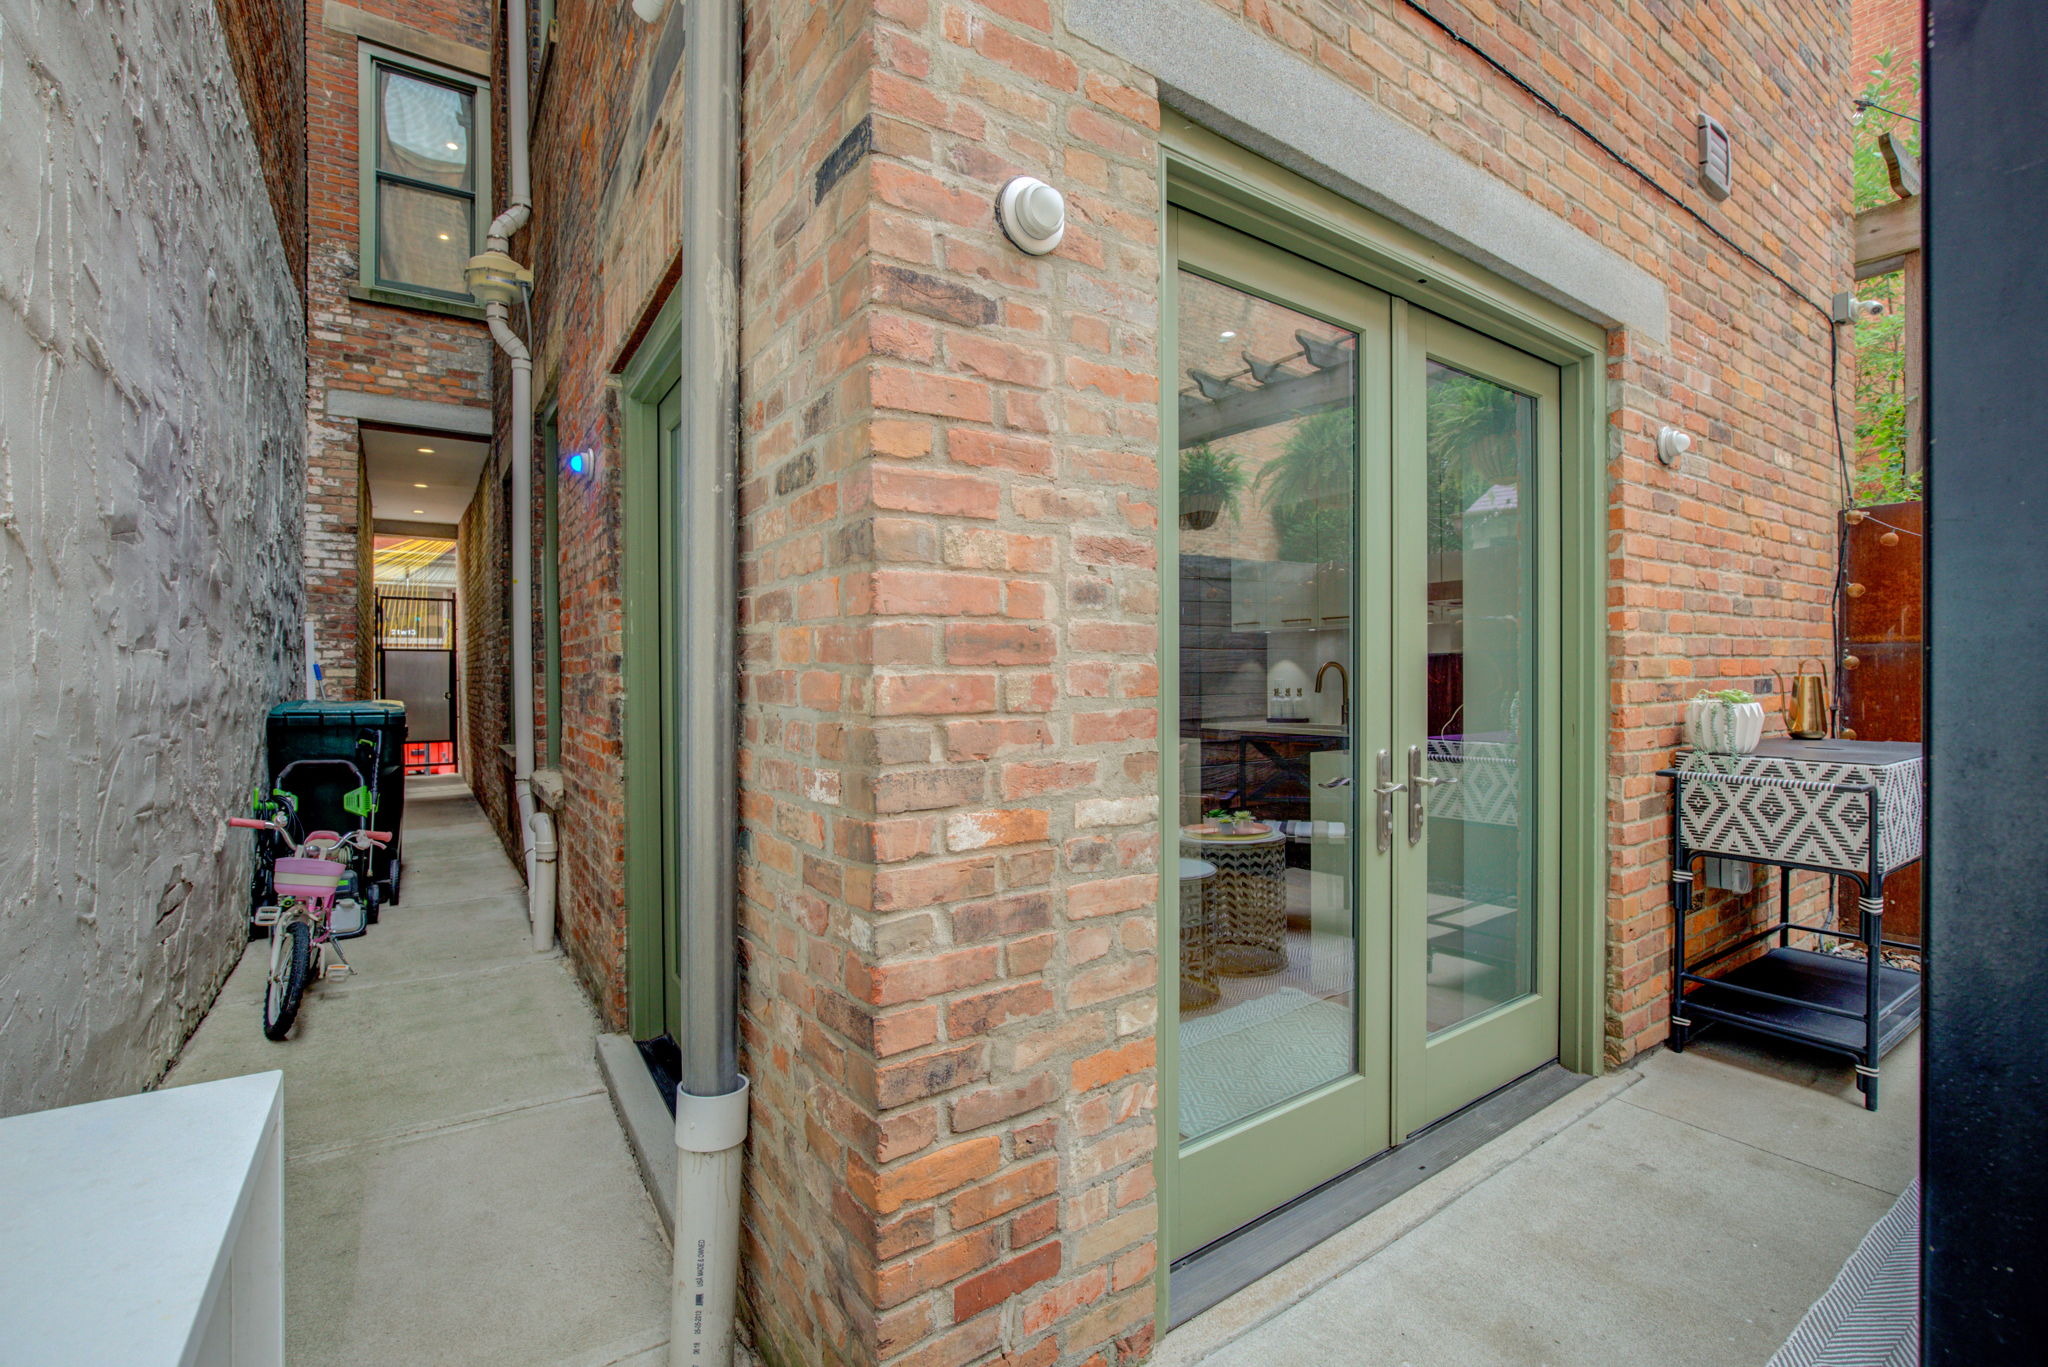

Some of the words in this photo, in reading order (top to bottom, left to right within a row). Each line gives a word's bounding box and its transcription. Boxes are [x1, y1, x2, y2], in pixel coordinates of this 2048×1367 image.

[697, 1239, 706, 1258] OWNED
[696, 1263, 704, 1277] MADE
[695, 1277, 704, 1288] USA
